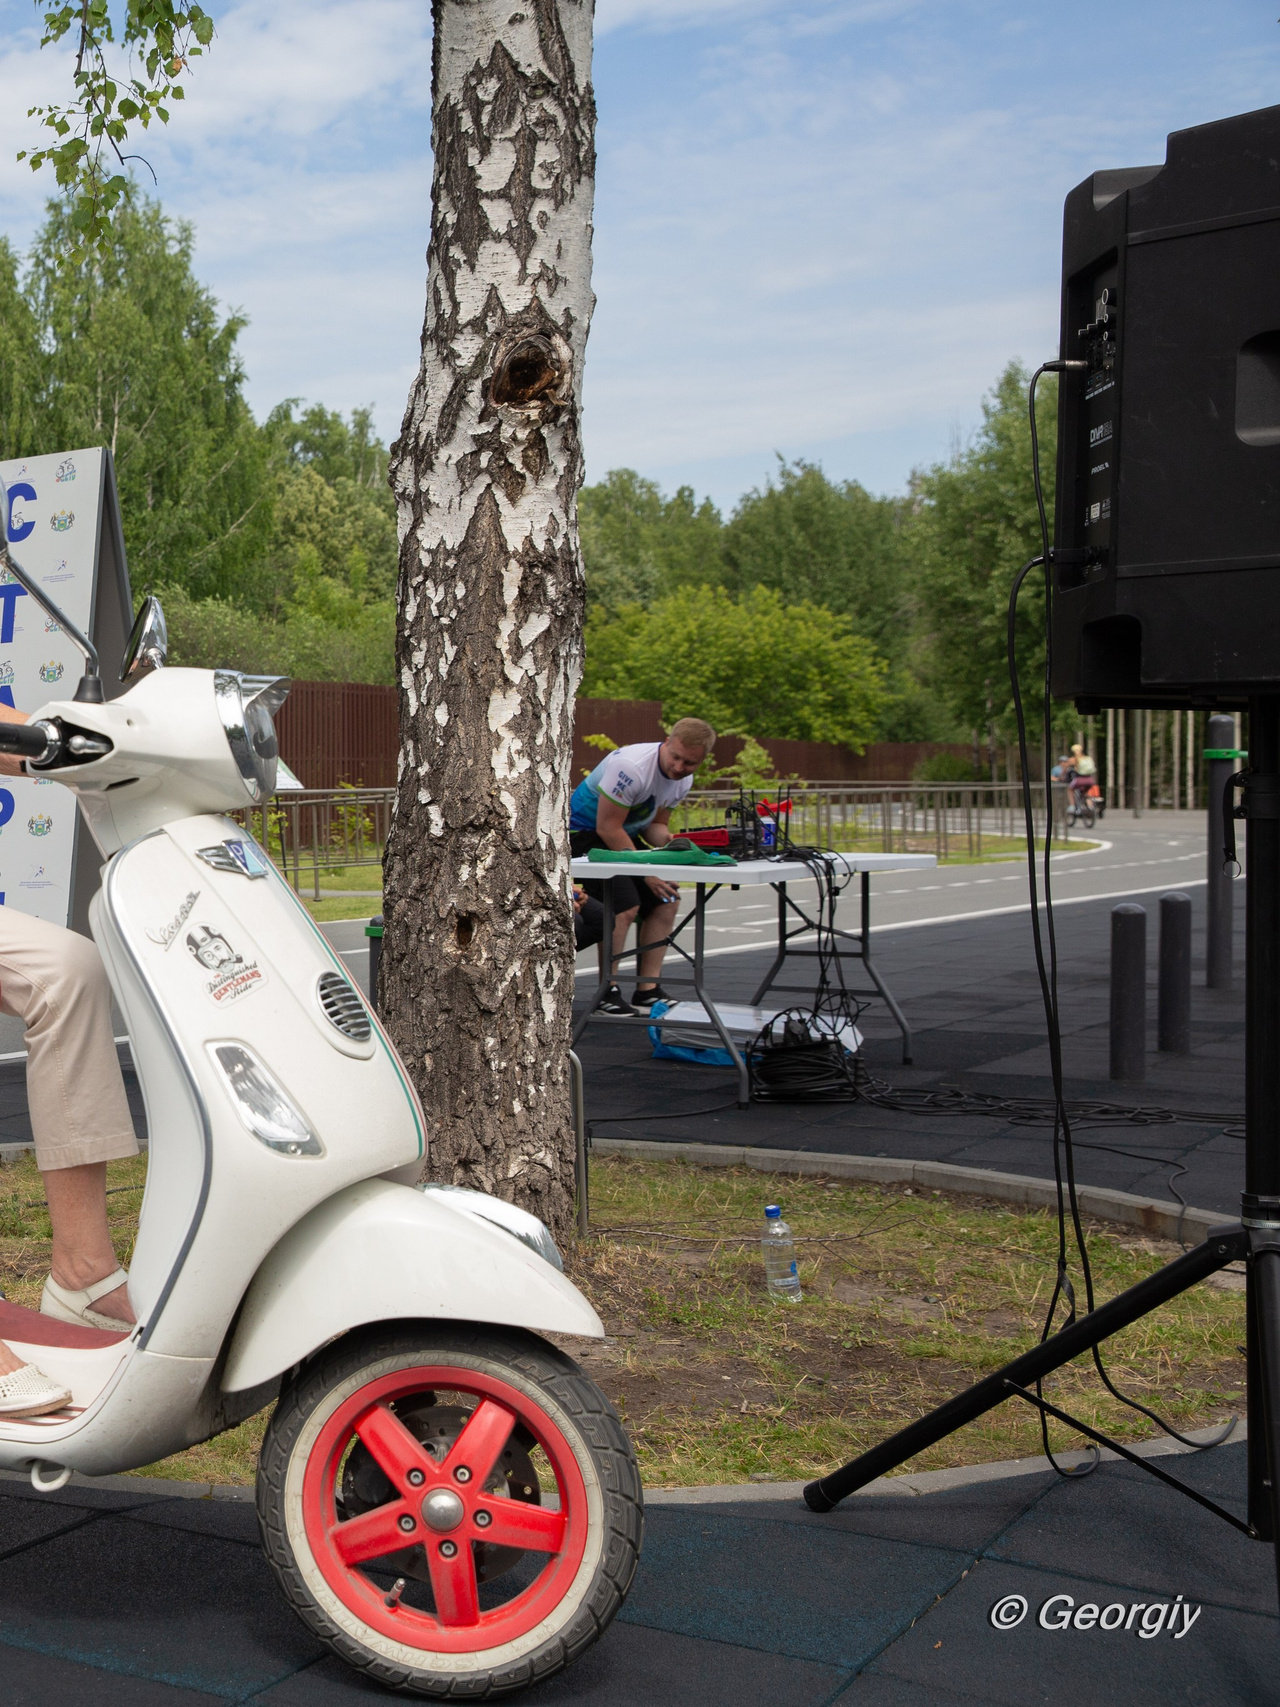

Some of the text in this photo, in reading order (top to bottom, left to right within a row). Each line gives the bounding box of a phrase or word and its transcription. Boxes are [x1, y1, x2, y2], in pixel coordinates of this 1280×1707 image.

[618, 770, 634, 786] GIVE
[207, 960, 258, 994] Distinguished
[213, 970, 262, 1001] GENTLEMANS
[230, 982, 253, 1000] Ride
